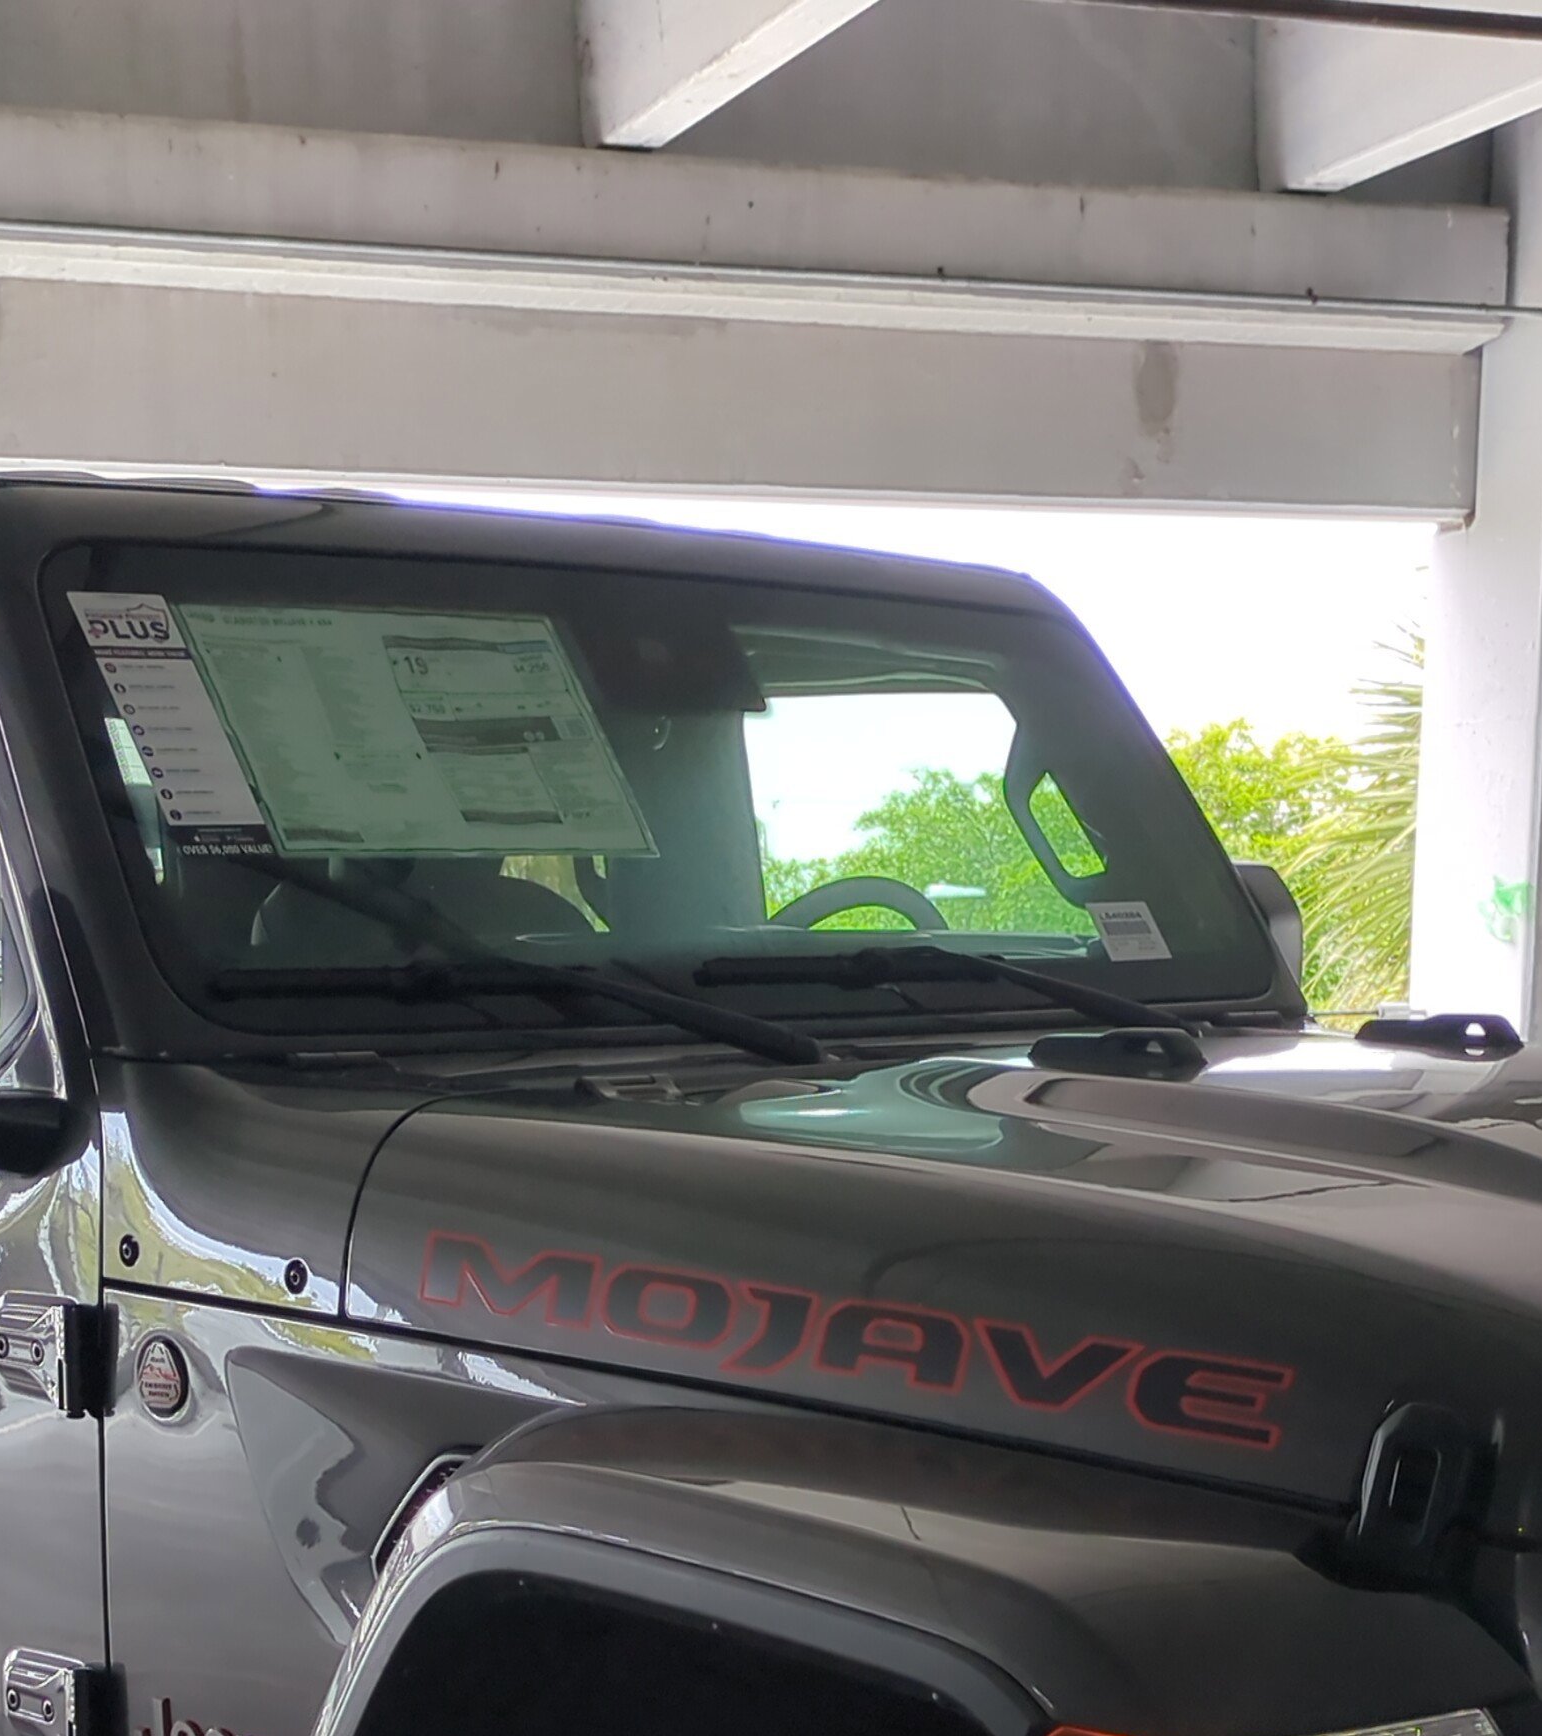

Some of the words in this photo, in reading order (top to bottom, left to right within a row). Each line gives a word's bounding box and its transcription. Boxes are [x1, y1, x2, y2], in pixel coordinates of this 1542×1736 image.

[87, 618, 171, 642] PLUS
[403, 654, 430, 676] 19
[182, 843, 209, 856] OVER
[417, 1230, 1295, 1451] MOJAVE
